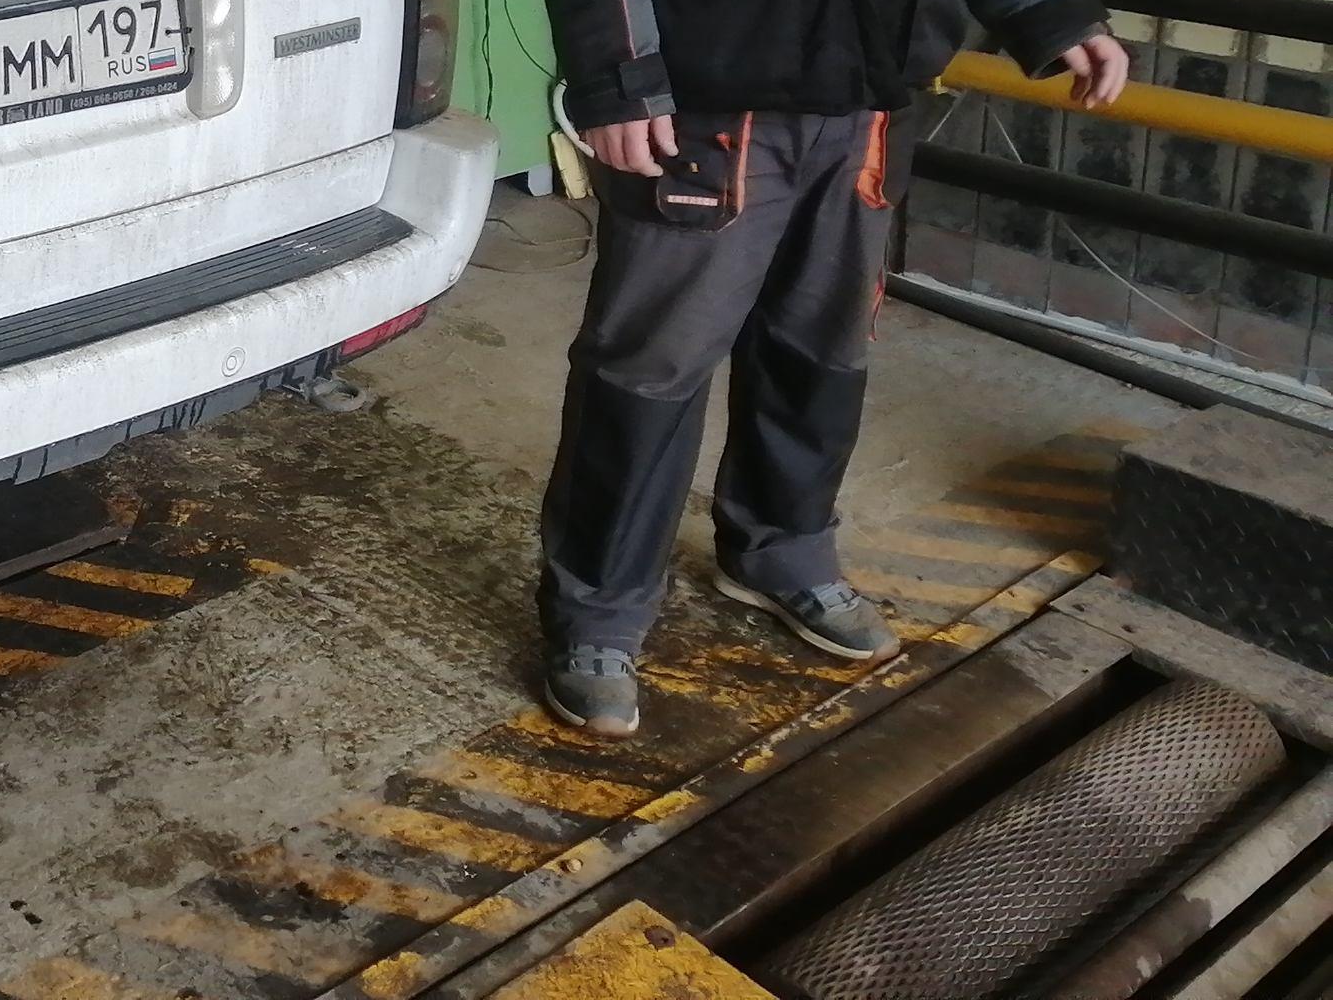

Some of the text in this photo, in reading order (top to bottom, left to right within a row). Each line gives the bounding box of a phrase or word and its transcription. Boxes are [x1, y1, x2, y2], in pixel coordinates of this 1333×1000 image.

[87, 0, 162, 57] 197
[279, 22, 360, 54] WESTMINSTER
[107, 55, 147, 78] RUS
[27, 98, 64, 120] LAND
